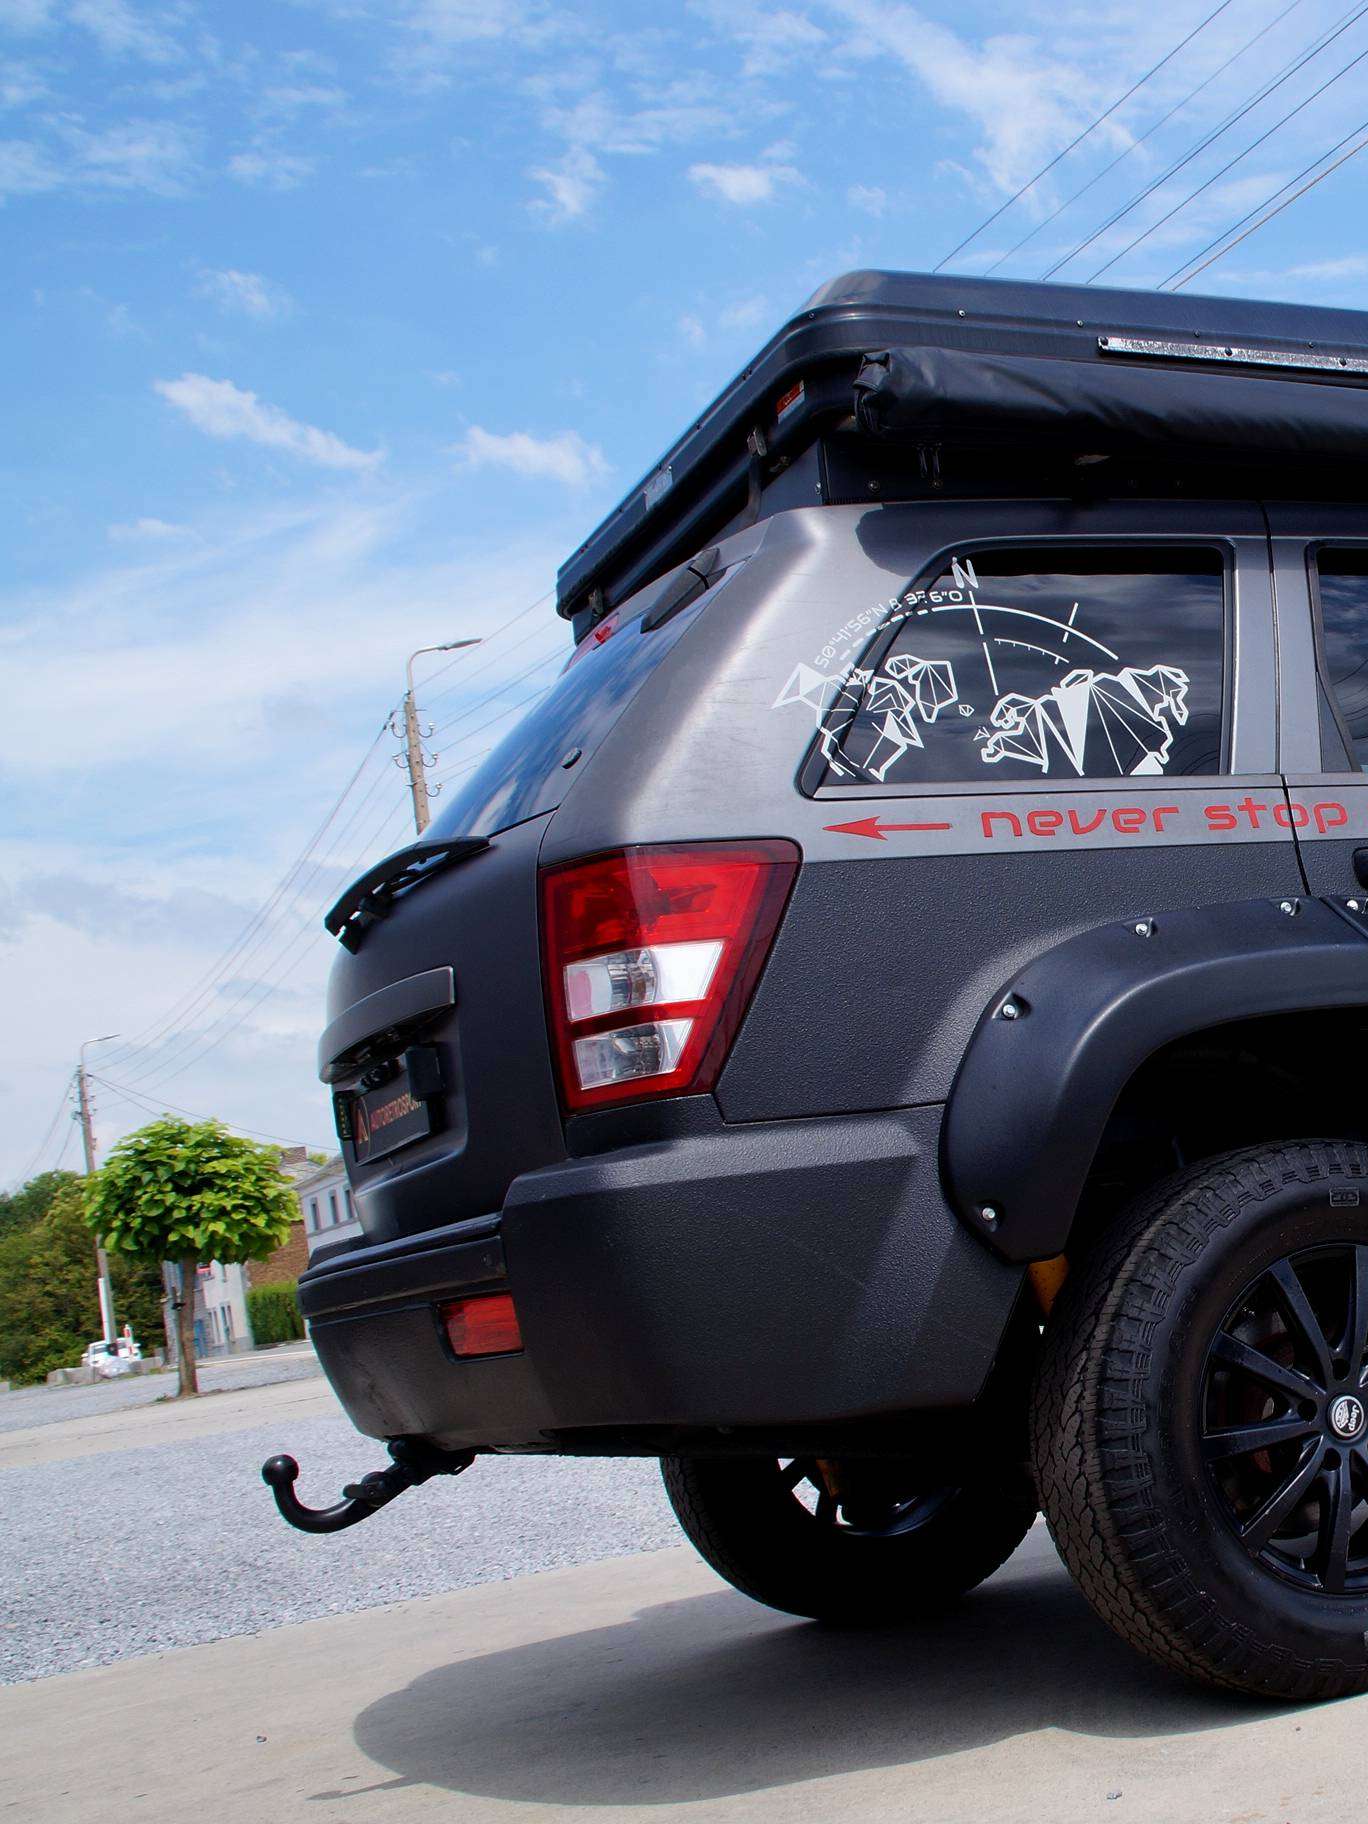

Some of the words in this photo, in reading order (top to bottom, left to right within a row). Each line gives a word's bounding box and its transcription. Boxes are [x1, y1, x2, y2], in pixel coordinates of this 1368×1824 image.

[952, 557, 979, 588] N
[980, 806, 1179, 838] never
[1203, 797, 1349, 833] stop
[1348, 1405, 1360, 1430] Jeep
